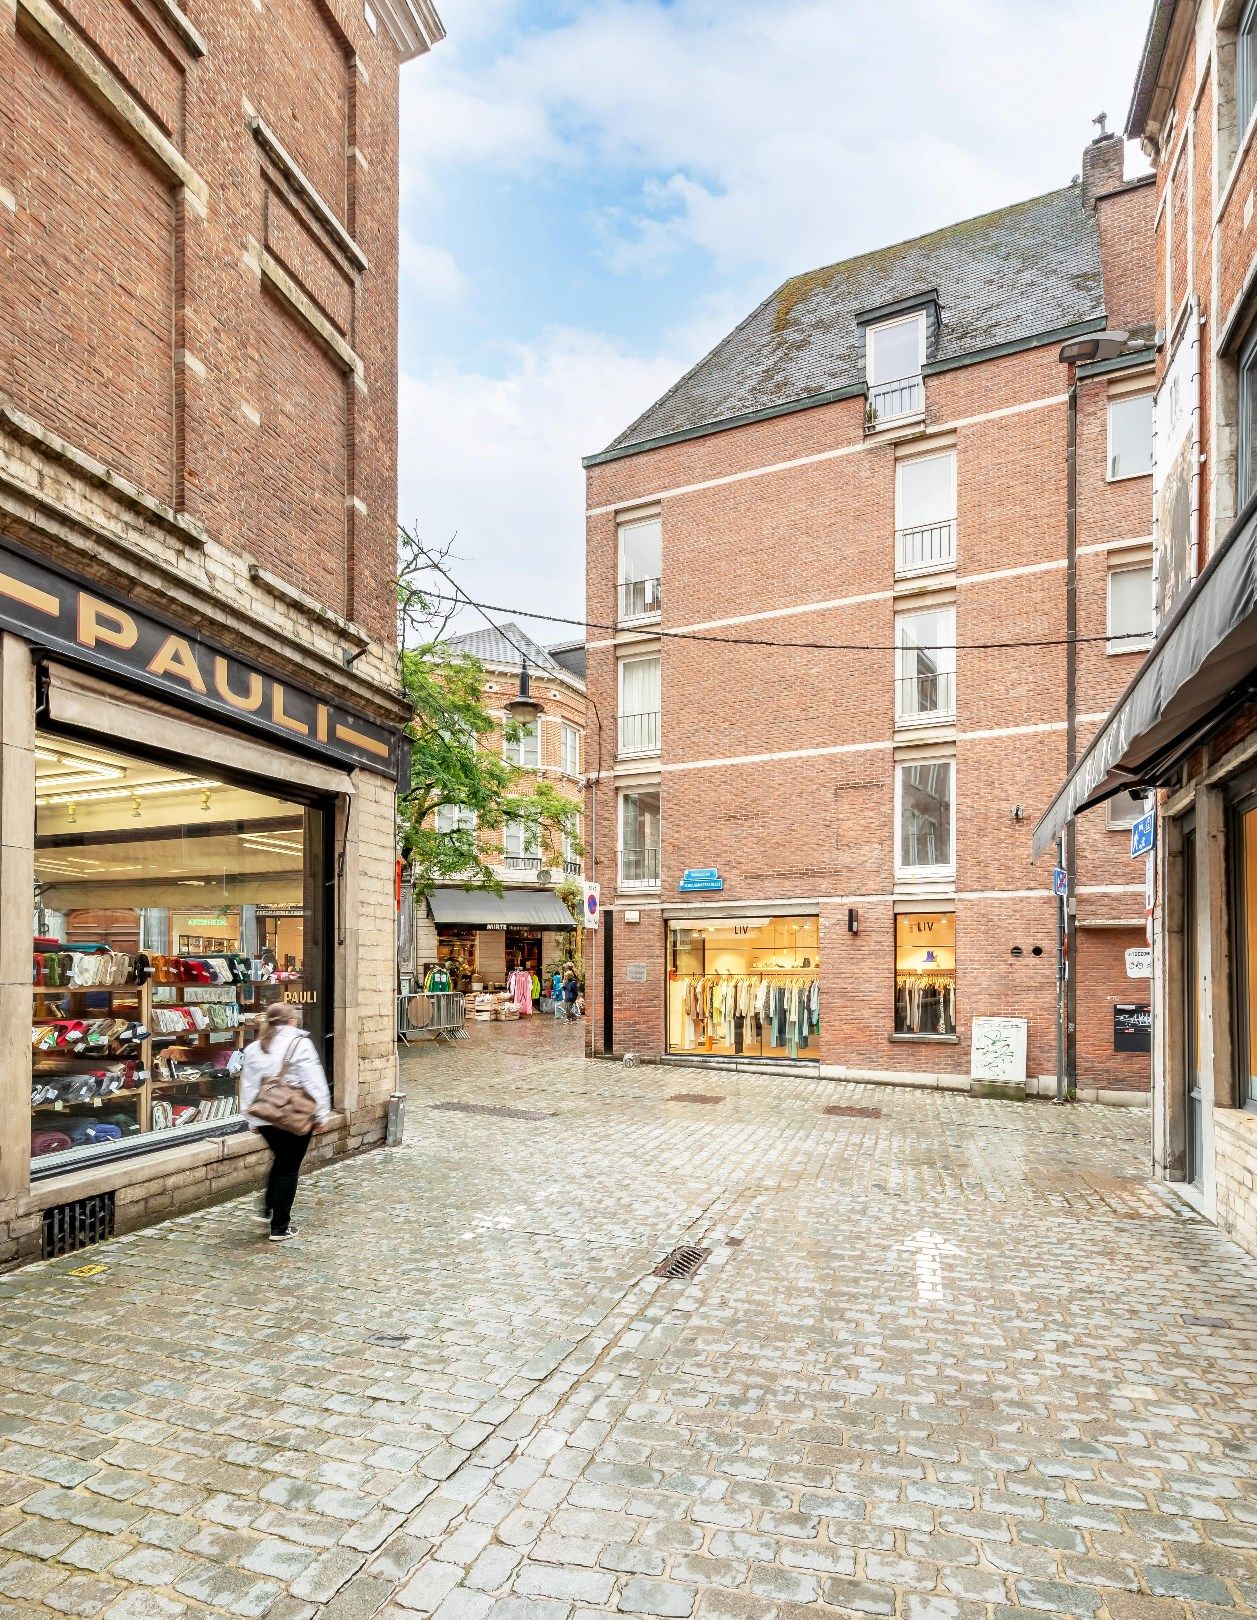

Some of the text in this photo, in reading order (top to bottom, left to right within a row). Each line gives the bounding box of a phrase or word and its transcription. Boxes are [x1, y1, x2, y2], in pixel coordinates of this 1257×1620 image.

[76, 592, 329, 743] PAULI
[734, 925, 749, 935] LIV
[917, 921, 934, 932] LIV
[284, 991, 317, 1004] PAULI
